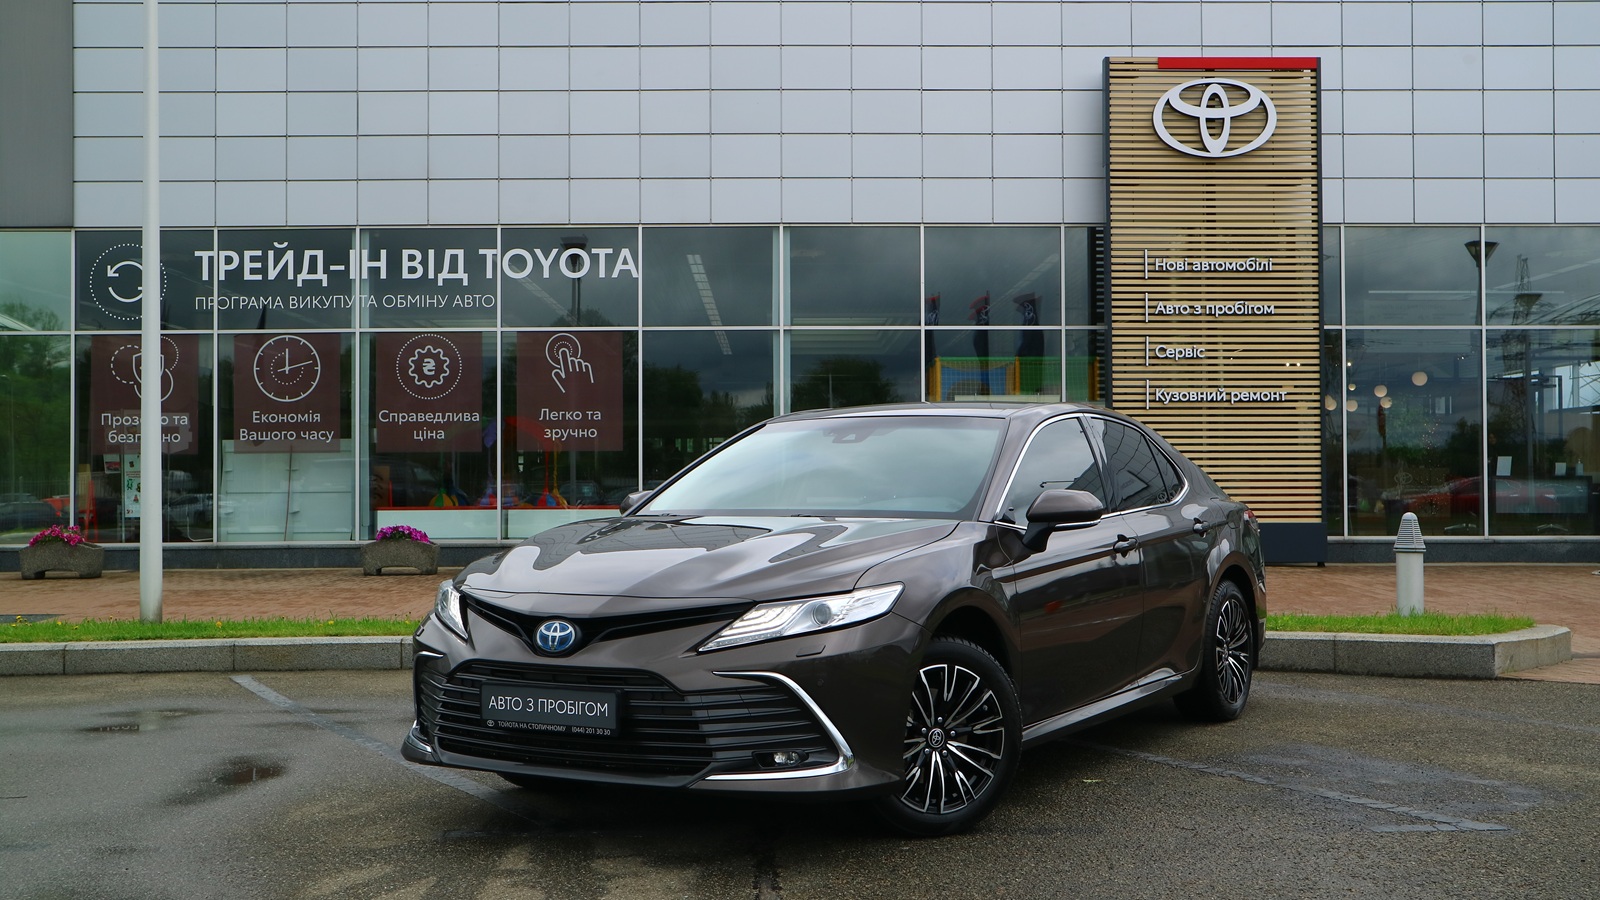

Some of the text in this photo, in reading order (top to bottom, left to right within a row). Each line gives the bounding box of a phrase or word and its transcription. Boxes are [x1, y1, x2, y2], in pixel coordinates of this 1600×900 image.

[194, 241, 639, 287] ТРЕЙД-ІН ВІД TOYOTA
[1155, 257, 1273, 271] Нові автомобілі
[195, 293, 495, 310] ПРОГРАМА ВИКУПУ ТА ОБМІНУ АВТО
[1155, 301, 1275, 317] Авто з пробігом
[1155, 345, 1205, 361] Сервіс
[1155, 388, 1288, 404] Кузовний ремонт
[101, 413, 188, 428] Прозо та
[252, 410, 321, 424] Економія
[378, 409, 480, 425] Справедлива
[539, 408, 602, 421] Легко та
[108, 430, 181, 443] безпно
[239, 428, 334, 443] Вашого часу
[413, 428, 445, 441] ціна
[543, 427, 598, 440] зручно
[488, 695, 522, 711] АВТО
[538, 699, 608, 717] ПРОБІГОМ
